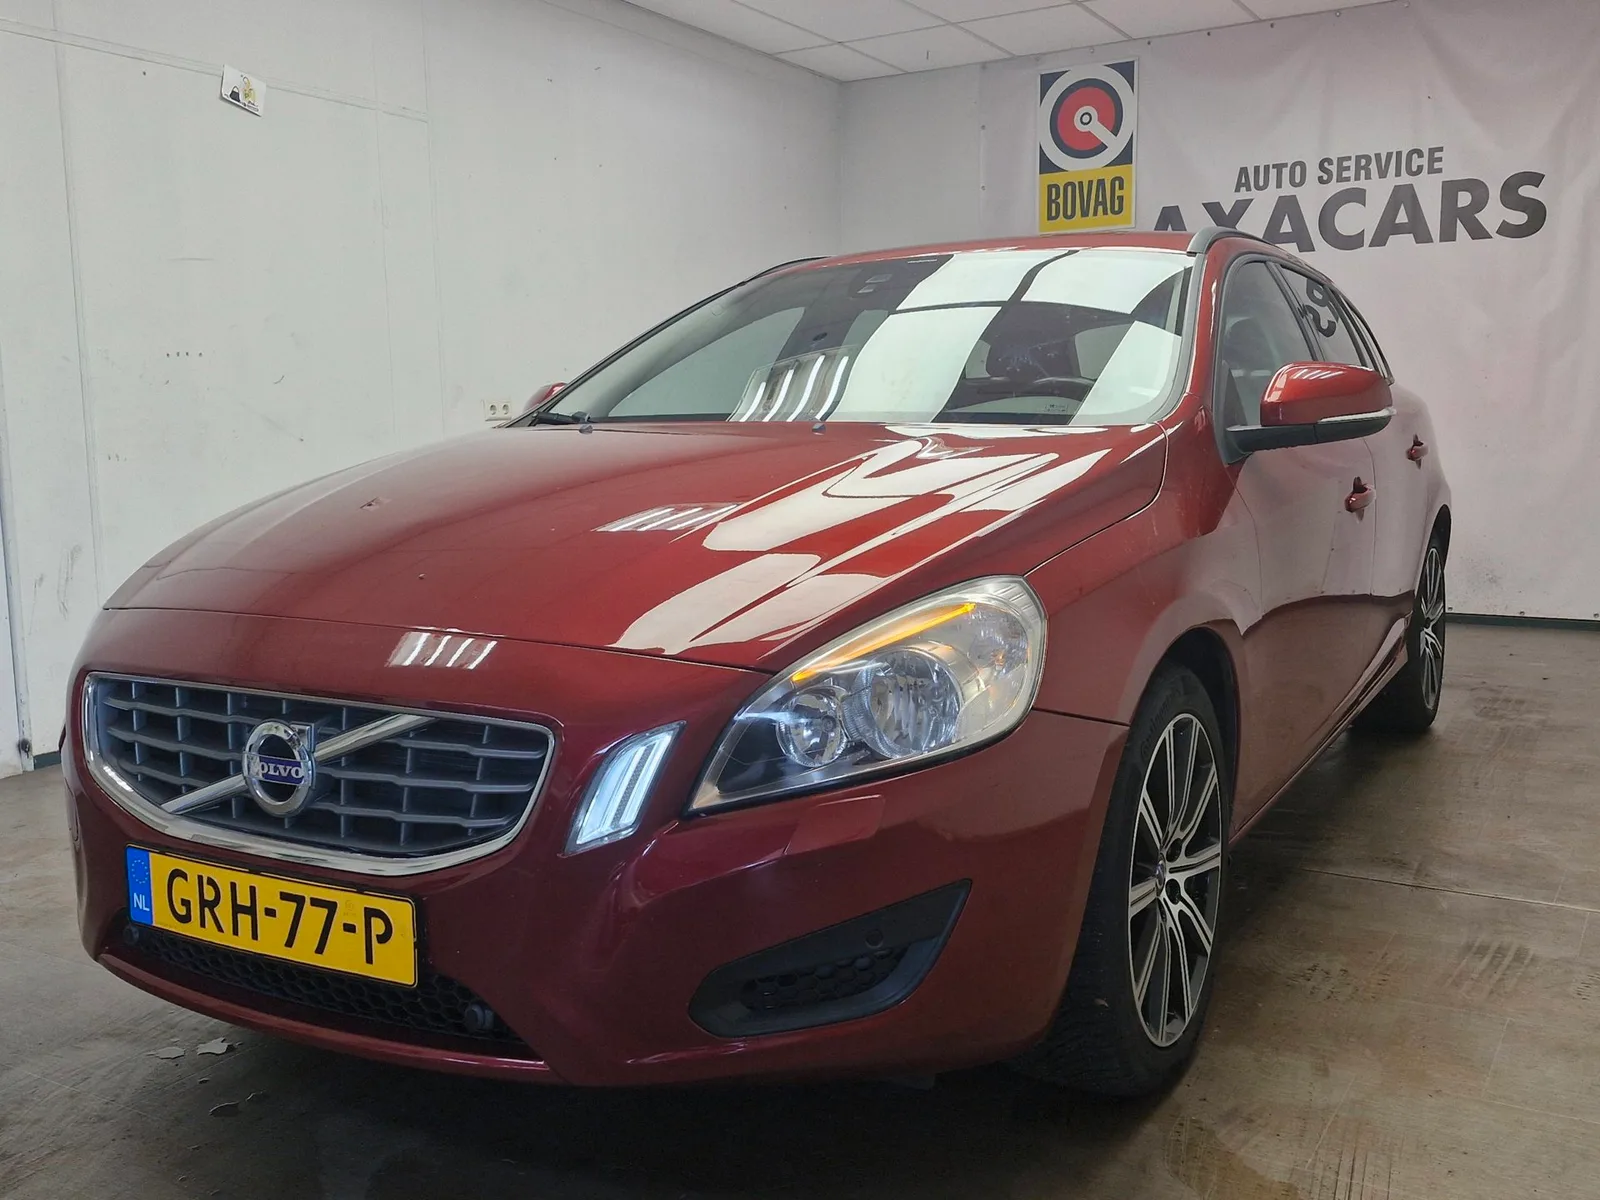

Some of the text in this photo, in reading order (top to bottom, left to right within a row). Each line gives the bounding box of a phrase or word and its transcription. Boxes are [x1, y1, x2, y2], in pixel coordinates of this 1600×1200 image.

[1234, 146, 1444, 194] AUTO SERVICE
[1046, 175, 1125, 222] BOVAG
[258, 761, 305, 779] OLVO
[133, 892, 150, 912] NL
[166, 868, 394, 965] GRH-77-P
